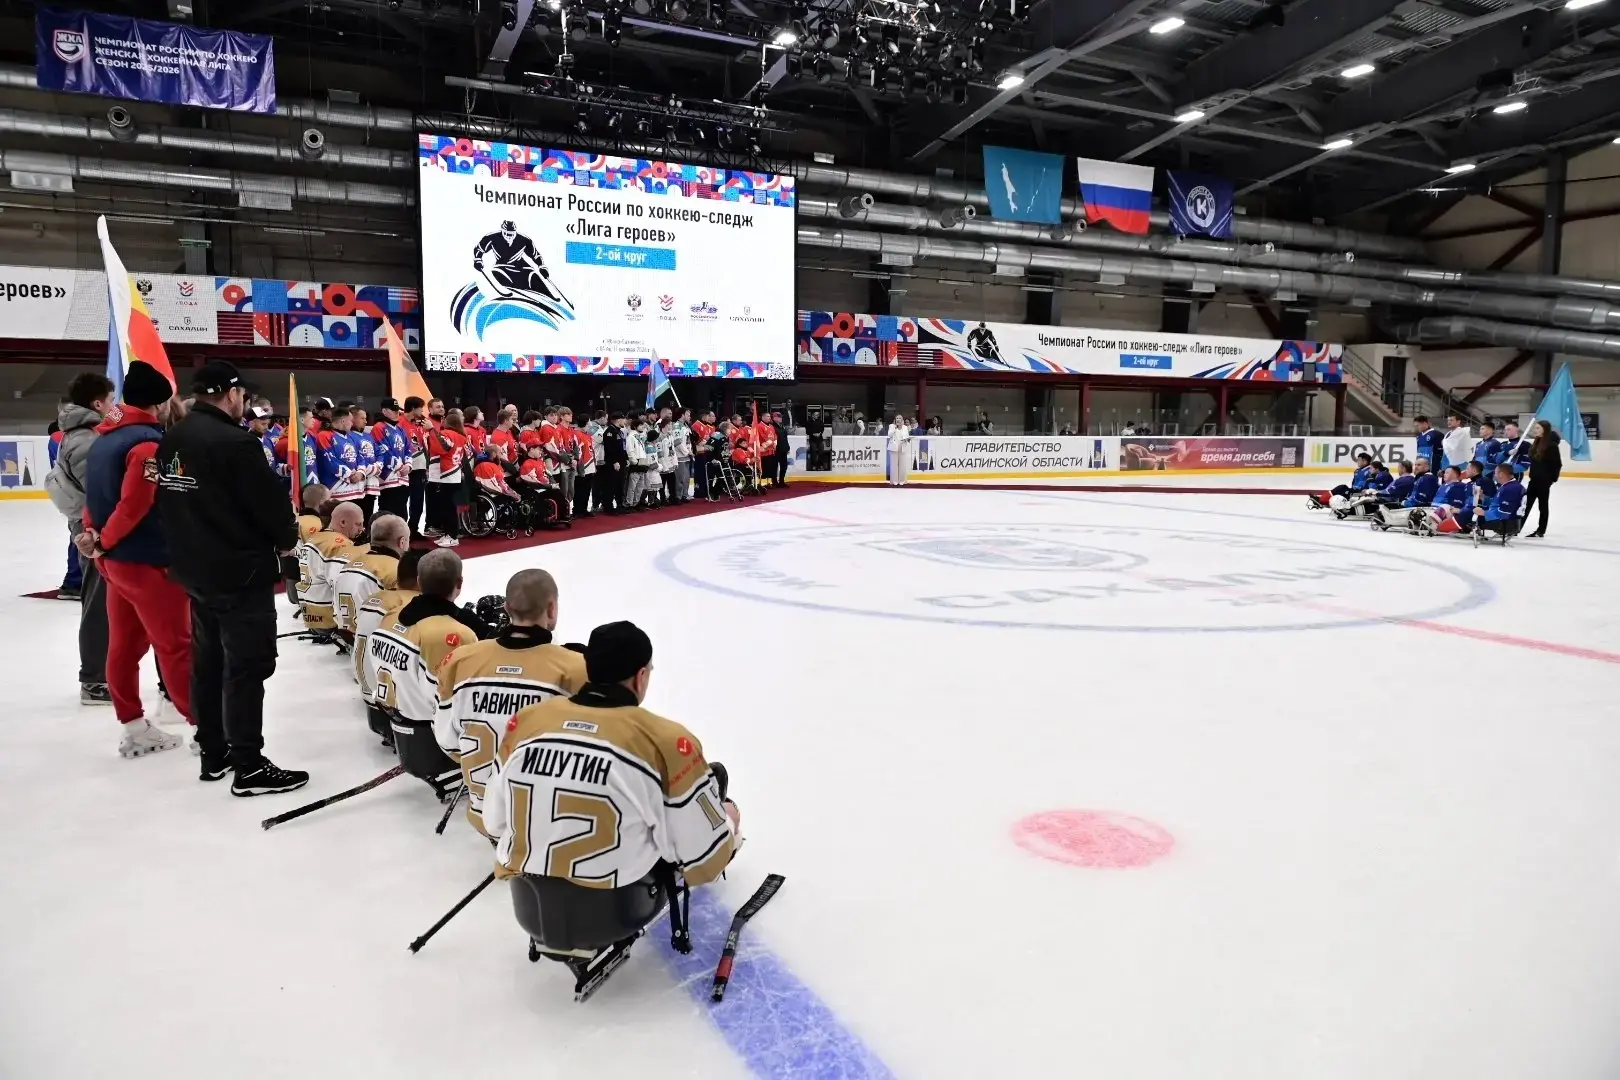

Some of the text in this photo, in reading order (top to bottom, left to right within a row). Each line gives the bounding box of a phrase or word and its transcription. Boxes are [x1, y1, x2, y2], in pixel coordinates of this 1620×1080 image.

[56, 32, 84, 44] ЖХЛ
[94, 36, 258, 65] ЧЕМПИОНАТ РОССИИ ПО ХОККЕЮ
[94, 46, 232, 71] ЖЕНСКАЯ ХОККЕЙНАЯ ЛИГА
[95, 57, 129, 69] СЕЗОН
[474, 183, 754, 228] Чемпионат России по хоккею-следж
[566, 218, 676, 244] «Лига героев»
[596, 246, 648, 265] 2-ой круг
[1038, 333, 1243, 357] Чемпионат России по хоккею-следж «Лига героев»
[964, 442, 1062, 454] ПРАВИТЕЛЬСТВО
[1200, 451, 1276, 463] время для себя
[1335, 443, 1404, 463] РОХБ
[940, 455, 1084, 469] САХАЛИНСКОЙ ОБЛАСТИ
[521, 747, 612, 785] ИШУТИН
[507, 779, 622, 889] 12
